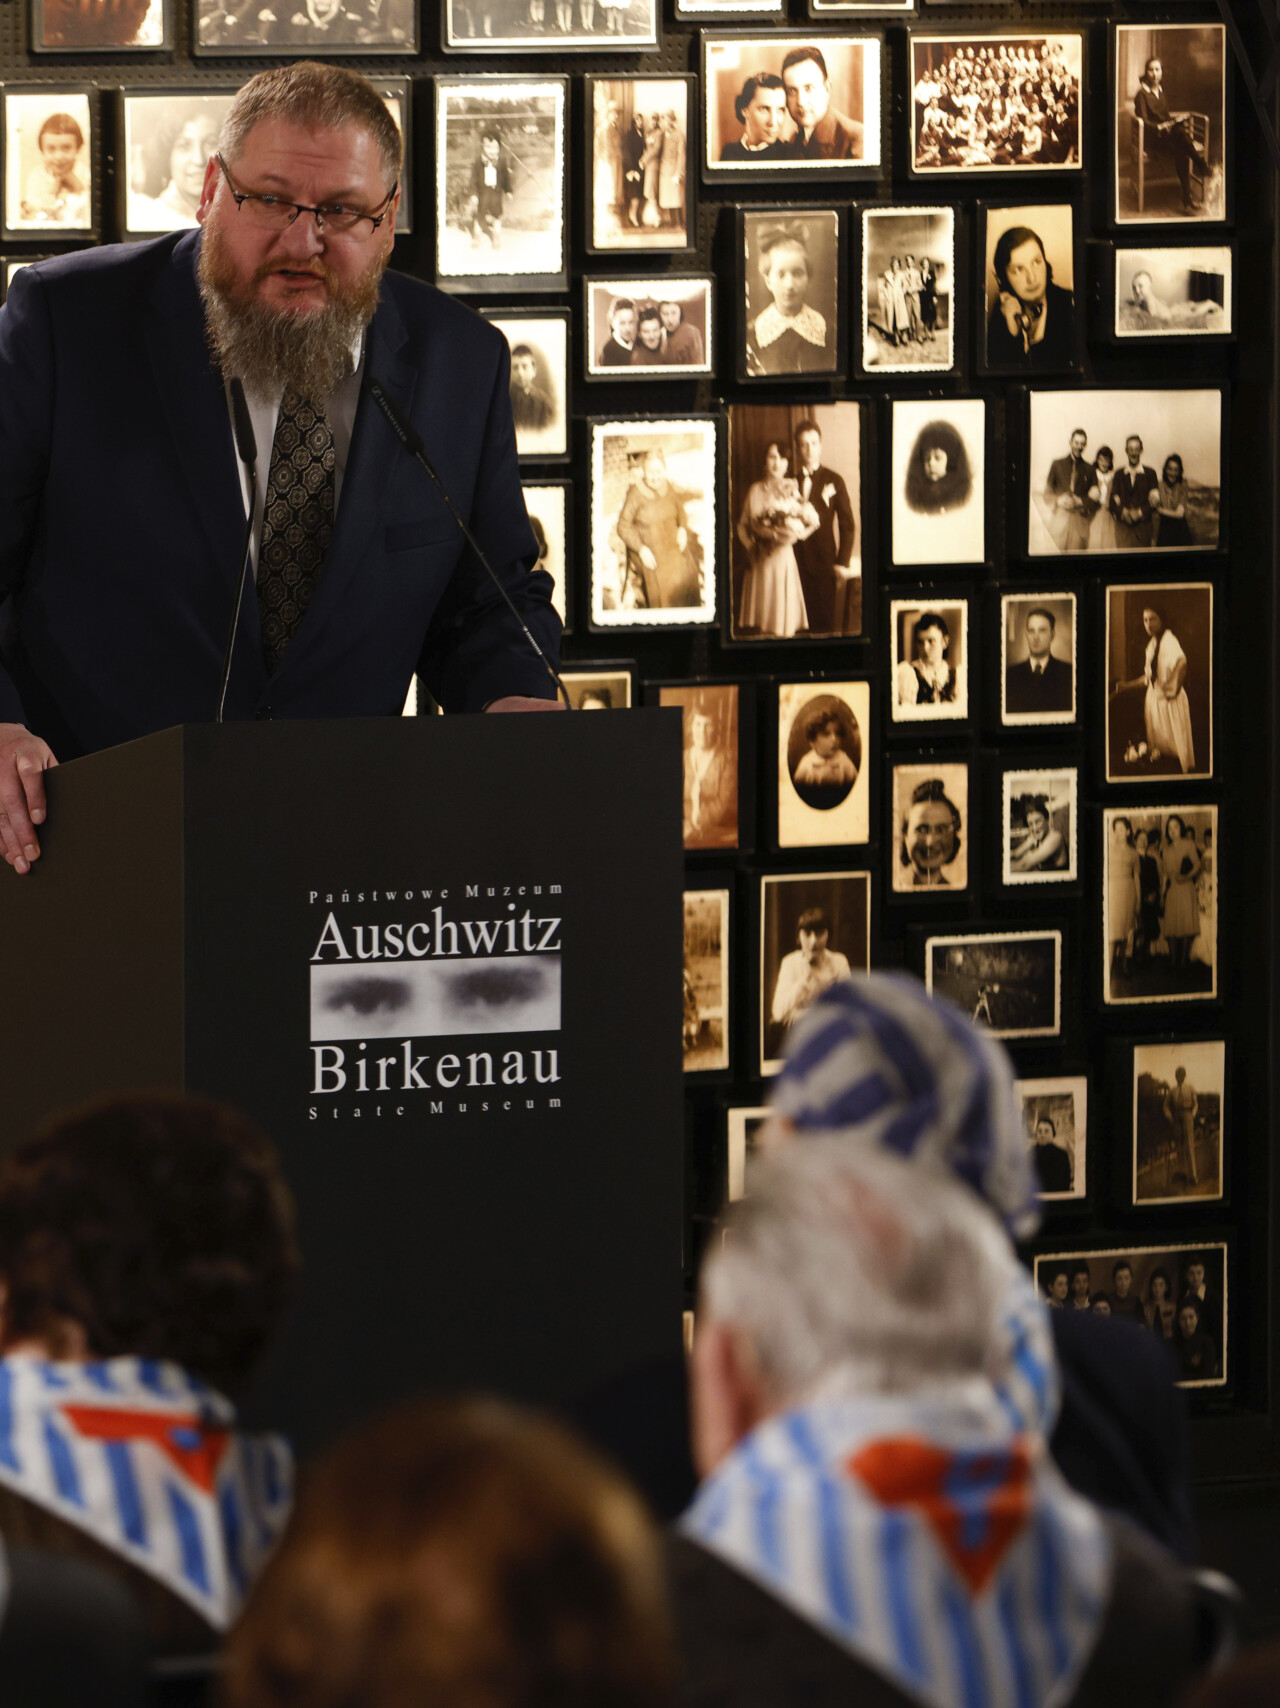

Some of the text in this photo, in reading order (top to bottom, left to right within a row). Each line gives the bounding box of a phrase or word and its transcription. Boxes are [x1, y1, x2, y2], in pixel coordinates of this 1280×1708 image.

[309, 884, 562, 904] Państwowe Muzeum
[309, 903, 562, 961] Auschwitz
[309, 1040, 562, 1094] Birkenau
[308, 1097, 561, 1120] State Museum
